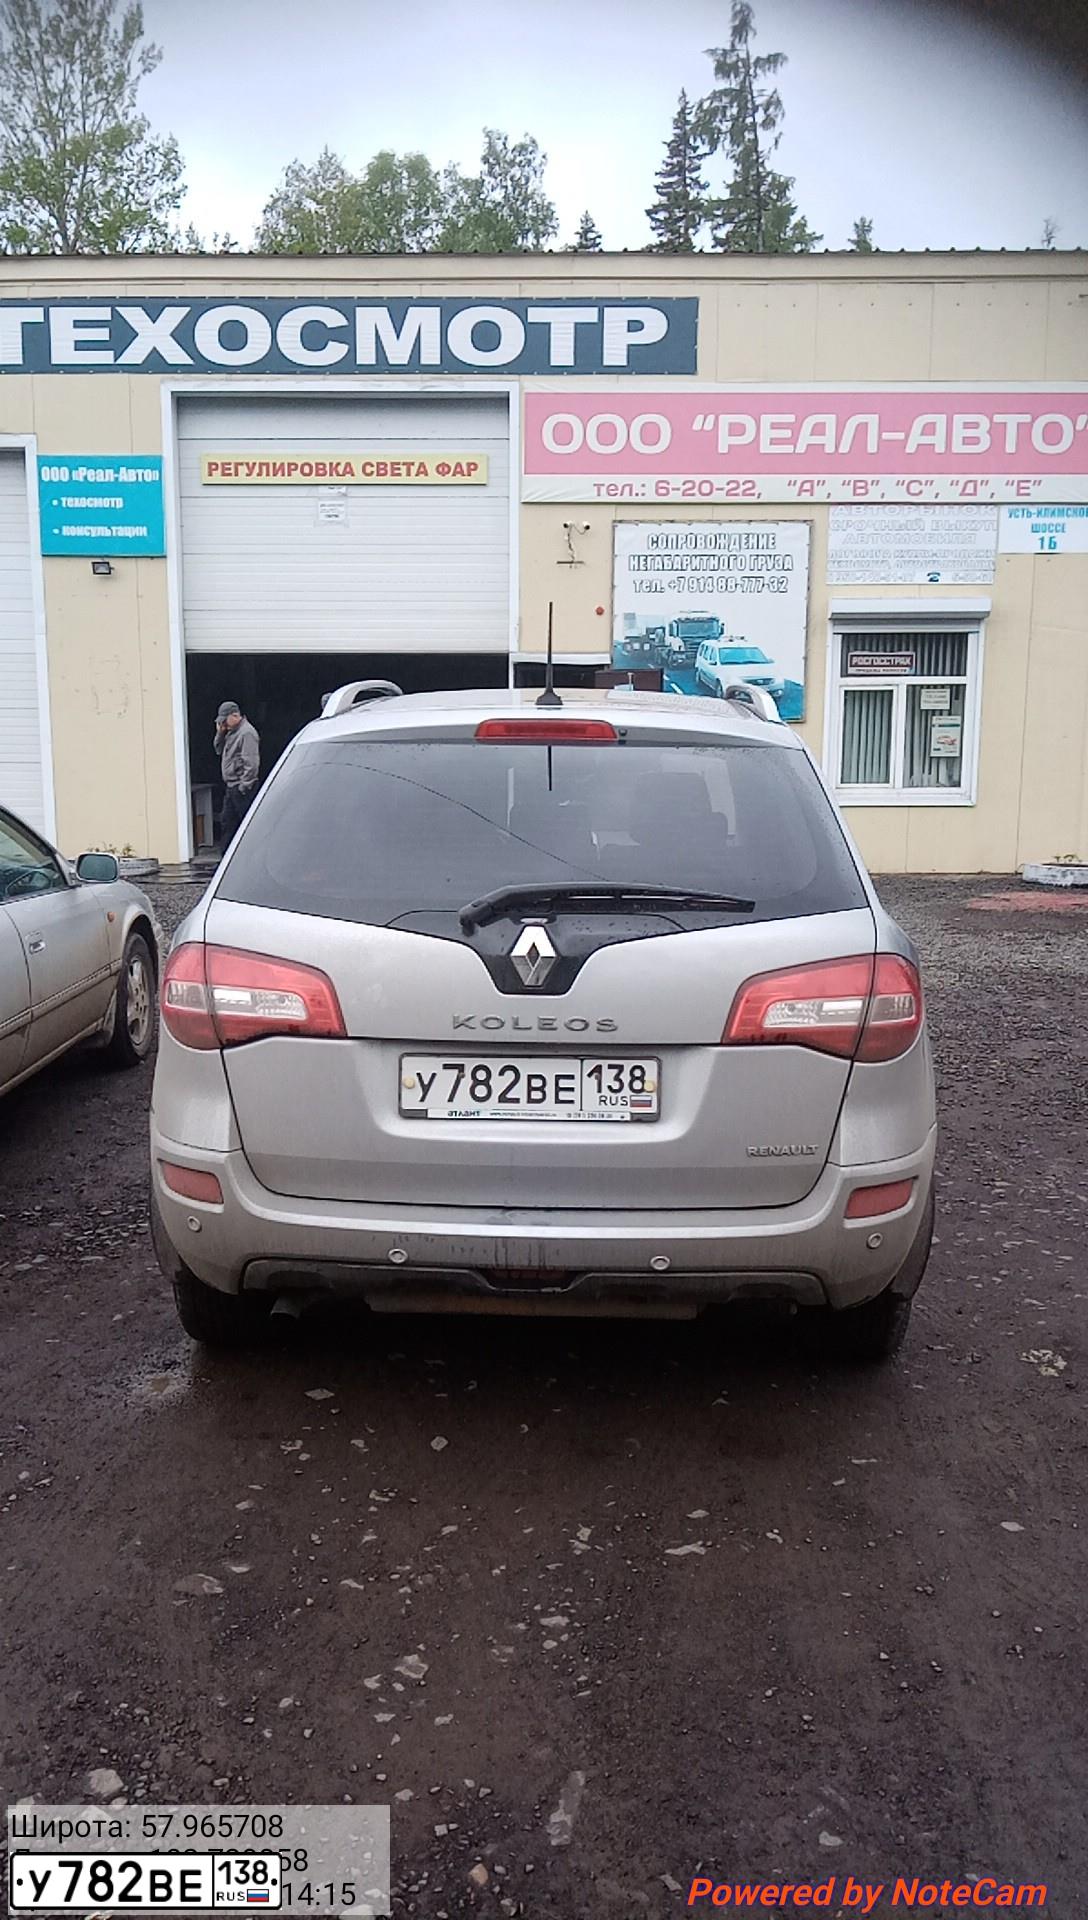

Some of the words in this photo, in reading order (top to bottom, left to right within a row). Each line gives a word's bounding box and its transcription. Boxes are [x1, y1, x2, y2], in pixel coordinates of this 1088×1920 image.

[0, 305, 668, 367] ТЕХОСМОТР
[541, 412, 673, 455] ООО
[41, 466, 70, 481] ООО
[207, 461, 354, 478] РЕГУЛИРОВКА
[361, 461, 428, 477] СВЕТА
[435, 460, 479, 477] ФАР
[593, 483, 646, 497] тел.:
[654, 479, 762, 499] 6-20-22,
[1031, 523, 1066, 533] ШОССЕ
[648, 533, 776, 551] СОПРОВОЖДЕНИЕ
[629, 555, 746, 571] НЕГАБАРИТНОГО
[750, 555, 793, 571] ГРУЗА
[452, 1014, 619, 1032] KOLEOS
[587, 1064, 647, 1093] 138
[598, 1095, 628, 1107] RUS
[747, 1144, 818, 1157] RENAULT
